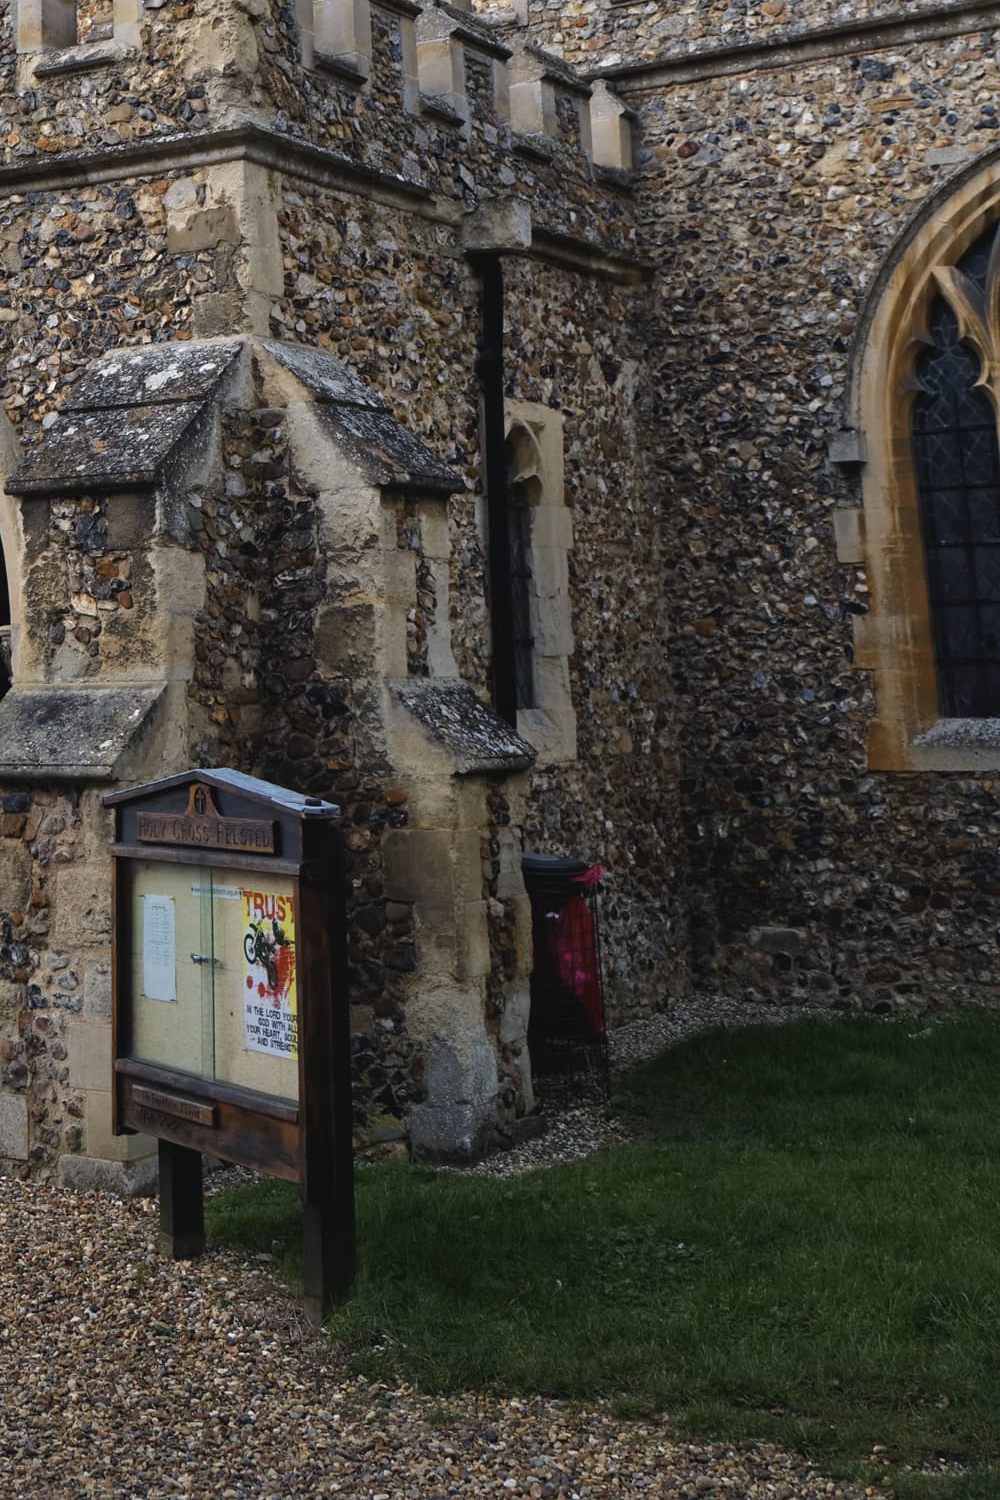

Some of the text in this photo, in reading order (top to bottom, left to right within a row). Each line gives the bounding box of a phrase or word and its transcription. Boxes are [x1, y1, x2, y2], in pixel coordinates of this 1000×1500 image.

[138, 816, 271, 848] HOLY CROSS FELSTED
[243, 890, 295, 924] TRUST
[254, 1006, 264, 1017] THE
[266, 1009, 281, 1020] LORD
[247, 1024, 260, 1035] YOUR
[258, 1017, 270, 1027] GOD
[272, 1020, 286, 1031] WITH
[257, 1036, 269, 1047] AND
